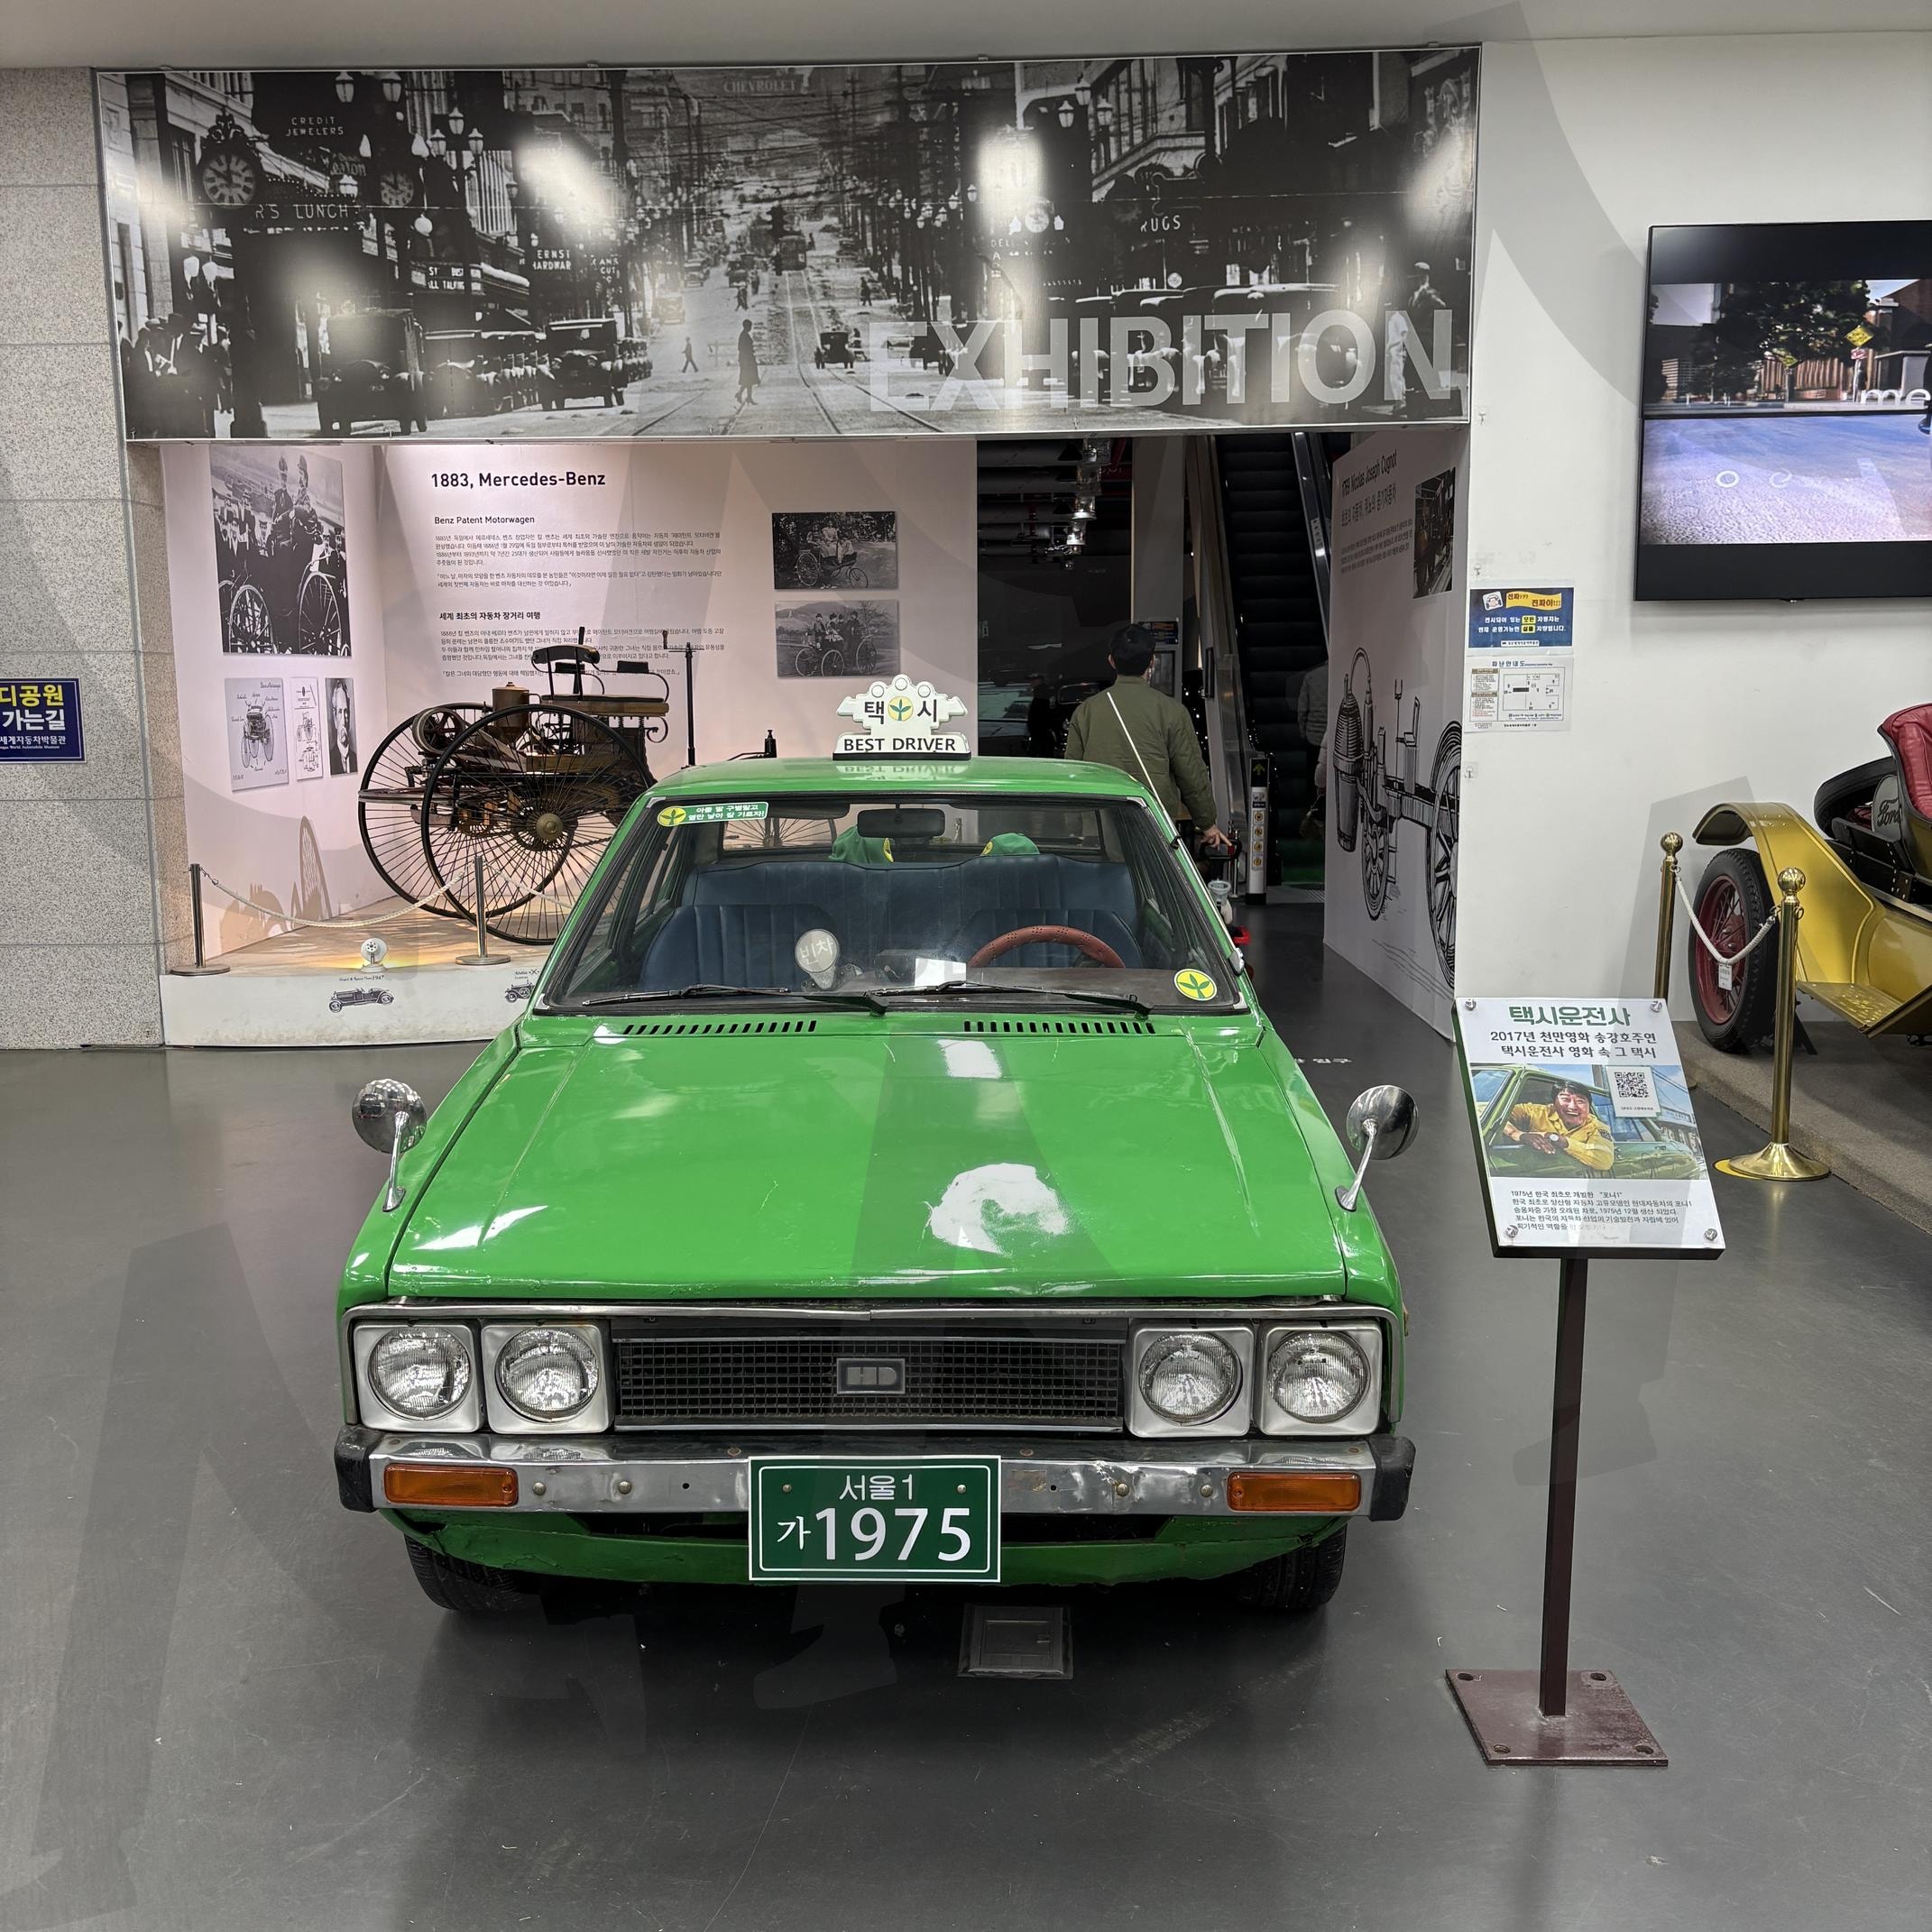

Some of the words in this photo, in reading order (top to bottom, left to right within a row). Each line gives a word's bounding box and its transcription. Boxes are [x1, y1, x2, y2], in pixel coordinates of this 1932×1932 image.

[290, 116, 336, 125] CREDIT
[286, 126, 345, 136] JEWELERS
[293, 204, 348, 219] LUNCH
[869, 309, 1452, 412] EXHIBITION
[431, 473, 474, 489] 1883,
[479, 472, 606, 487] Mercedes-Benz
[434, 517, 455, 525] Benz
[456, 516, 483, 525] Patent
[484, 515, 535, 526] Motorwagen
[439, 612, 454, 621] 세계
[455, 612, 477, 621] 최초의
[479, 612, 501, 620] 자동차
[502, 611, 523, 620] 장거리
[526, 611, 540, 619] 여행
[2, 708, 66, 731] 가는길
[843, 738, 886, 751] BEST
[892, 738, 956, 751] DRIVER
[798, 937, 834, 965] 빈차
[1508, 1006, 1632, 1026] 택시운전사
[1490, 1031, 1537, 1043] 2017년
[1539, 1031, 1591, 1044] 천만영화
[1595, 1032, 1658, 1044] 송강호주연
[1501, 1045, 1565, 1058] 택시운전사
[1569, 1045, 1595, 1058] 영화
[1598, 1046, 1611, 1059] 속
[1615, 1046, 1628, 1057] 그
[1631, 1046, 1657, 1059] 택시
